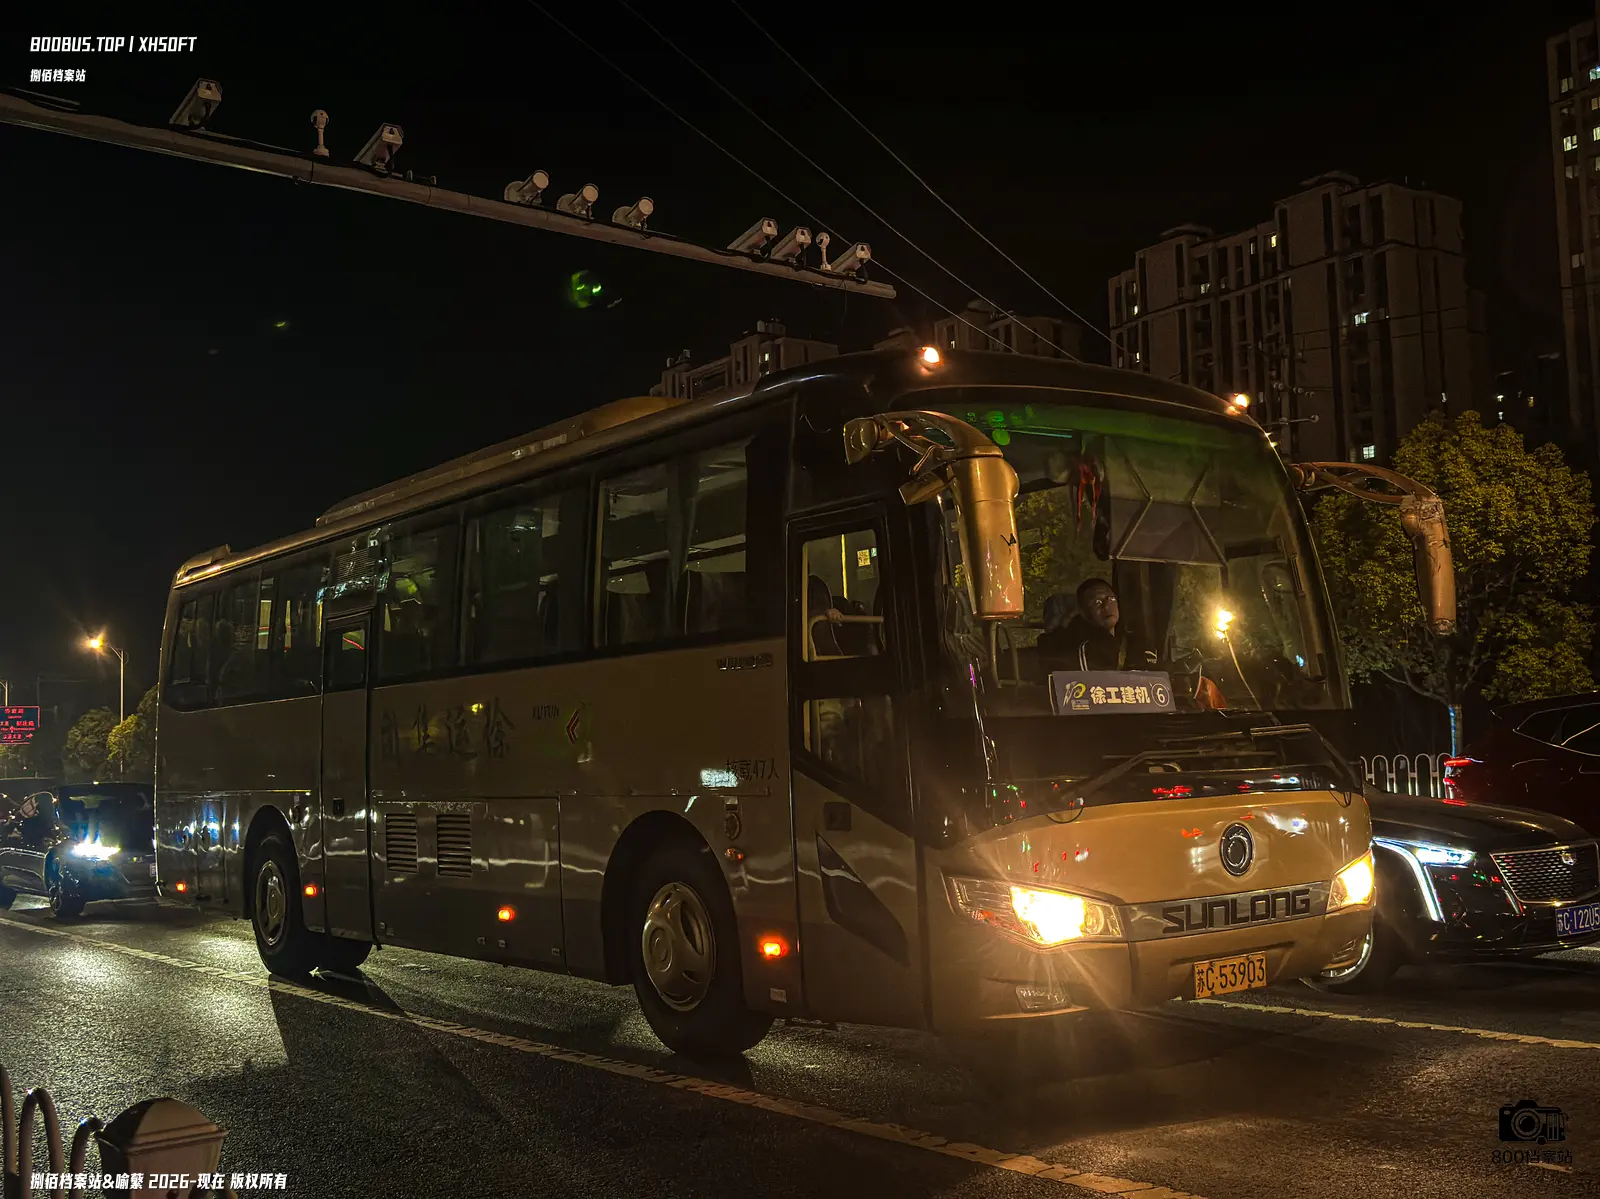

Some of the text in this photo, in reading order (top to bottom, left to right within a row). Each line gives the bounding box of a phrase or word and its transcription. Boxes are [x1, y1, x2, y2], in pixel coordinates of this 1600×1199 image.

[1089, 685, 1151, 705] 徐工建机
[1162, 888, 1311, 934] SUNLONG
